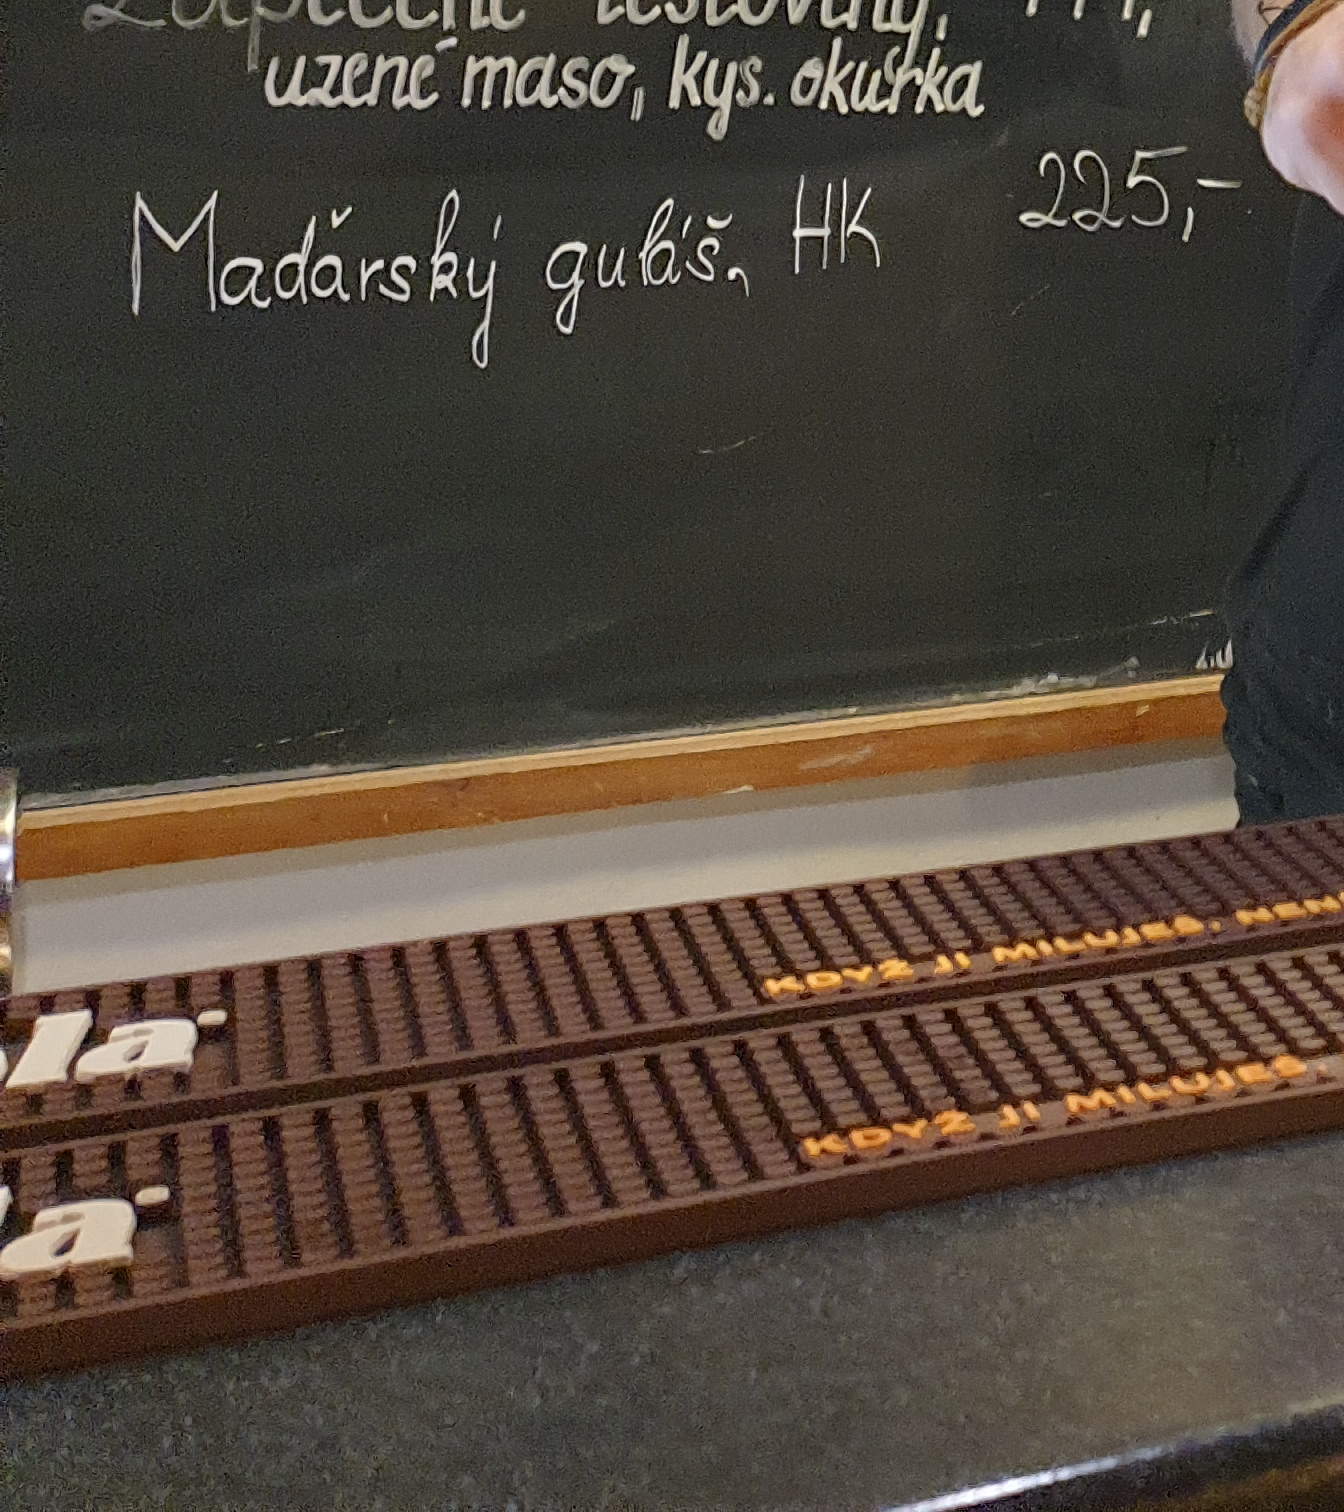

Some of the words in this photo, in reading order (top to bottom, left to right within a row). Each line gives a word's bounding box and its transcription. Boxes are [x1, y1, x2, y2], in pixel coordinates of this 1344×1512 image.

[264, 36, 459, 109] uzené
[459, 53, 646, 121] maso,
[667, 35, 776, 140] kys.
[130, 188, 503, 369] Maďarský
[544, 196, 751, 335] guláš,
[792, 174, 882, 275] HK
[1019, 146, 1242, 242] 225,-
